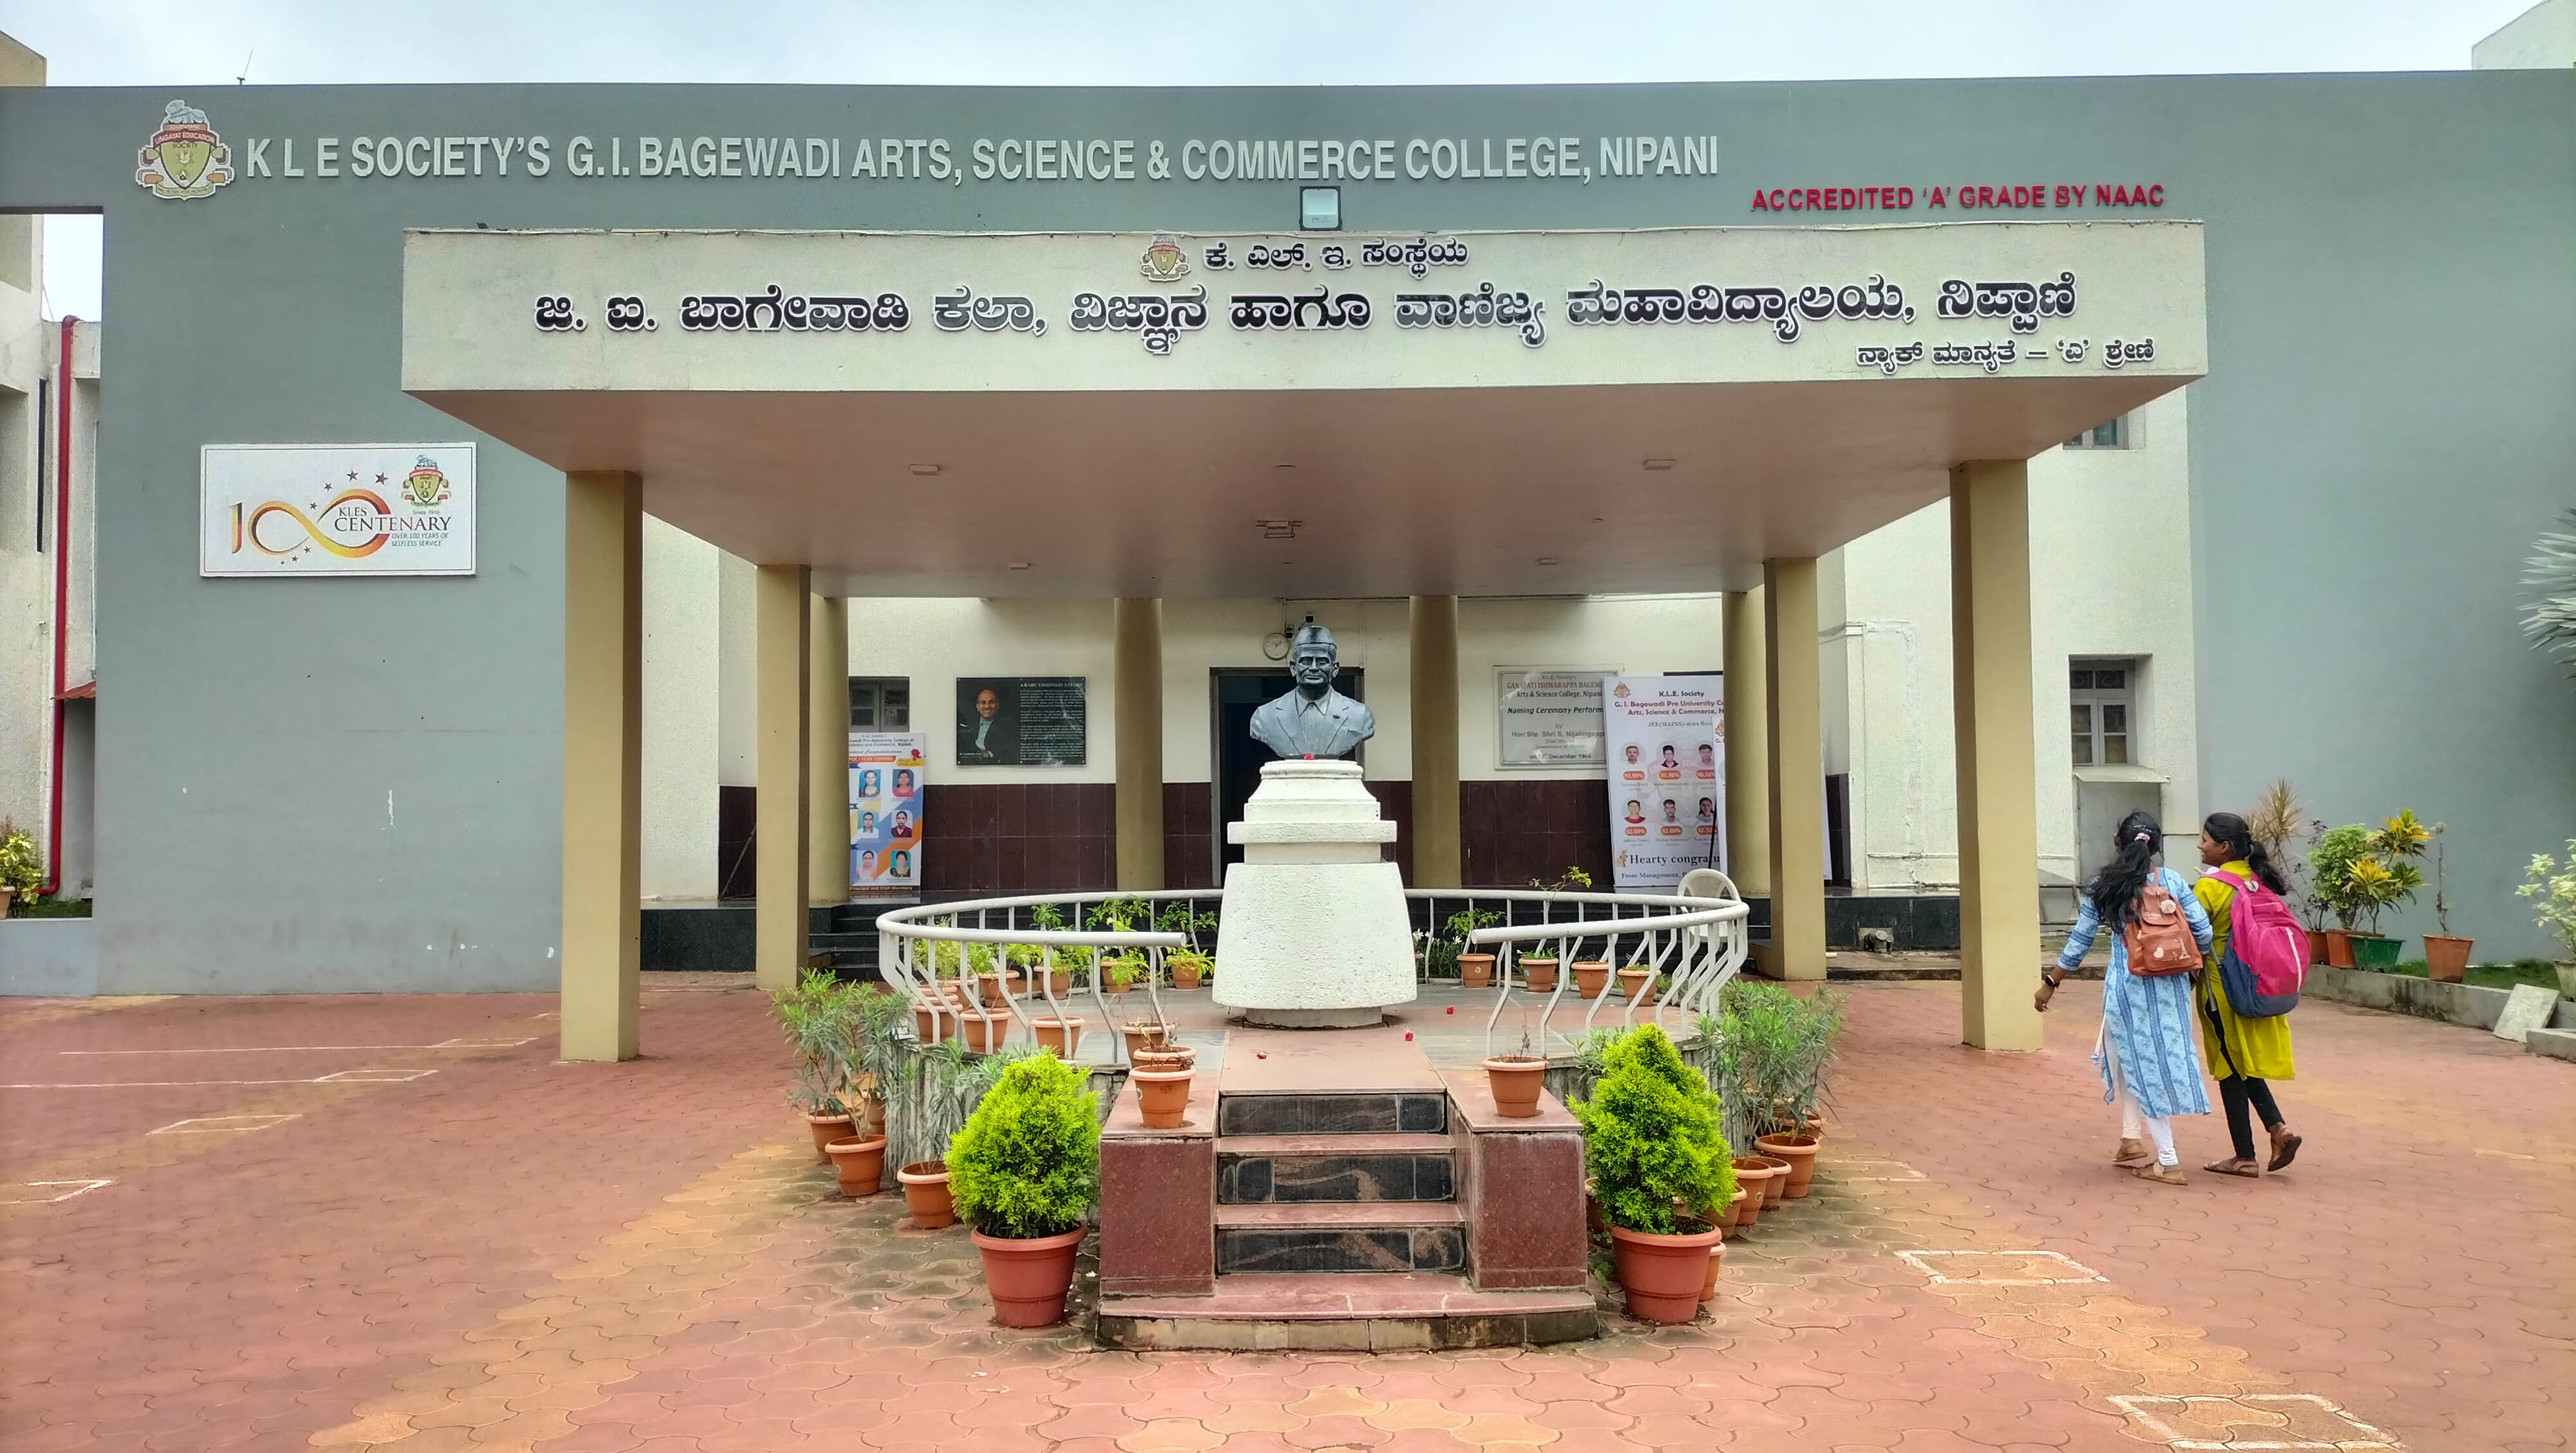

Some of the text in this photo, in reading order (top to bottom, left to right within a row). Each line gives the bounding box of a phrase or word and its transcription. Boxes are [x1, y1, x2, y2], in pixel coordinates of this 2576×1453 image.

[155, 132, 215, 144] LINGAYAT EDUCATION
[351, 136, 551, 177] SOCIETY'S
[851, 137, 963, 186] ARTS,
[972, 138, 1136, 180] SCIENCE
[1146, 140, 1171, 180] &
[1182, 138, 1396, 181] COMMERCE
[1405, 137, 1591, 184] COLLEGE,
[1599, 136, 1718, 177] NIPANI
[1752, 187, 1914, 211] ACCREDITED
[1960, 185, 2047, 207] GRADE
[2054, 185, 2087, 207] BY
[2096, 184, 2164, 206] NAAC
[1204, 242, 1236, 269] ಕೆ.
[1247, 242, 1312, 272] ಎಲ್.
[1361, 237, 1469, 280] ಸಂಸ್ಥೆಯ
[535, 271, 2076, 354] ಜಿ. ಐ. ಬಾಗೇವಾಡಿ ಕಲಾ, ವಿಜ್ಞಾನ ಹಾಗೂ ವಾಣಿಜ್ಯ ಮಹಾವಿದ್ಯಾಲಯ, ನಿಪ್ಪಾಣಿ
[1857, 341, 1924, 375] ನ್ಯಾಕ್
[1932, 339, 2017, 374] ಮಾನ್ಯತೆ
[2102, 337, 2155, 369] ಶ್ರೇಣಿ
[334, 517, 451, 532] CENTENARY
[339, 507, 368, 517] KLES
[1630, 855, 1667, 866] Hearty
